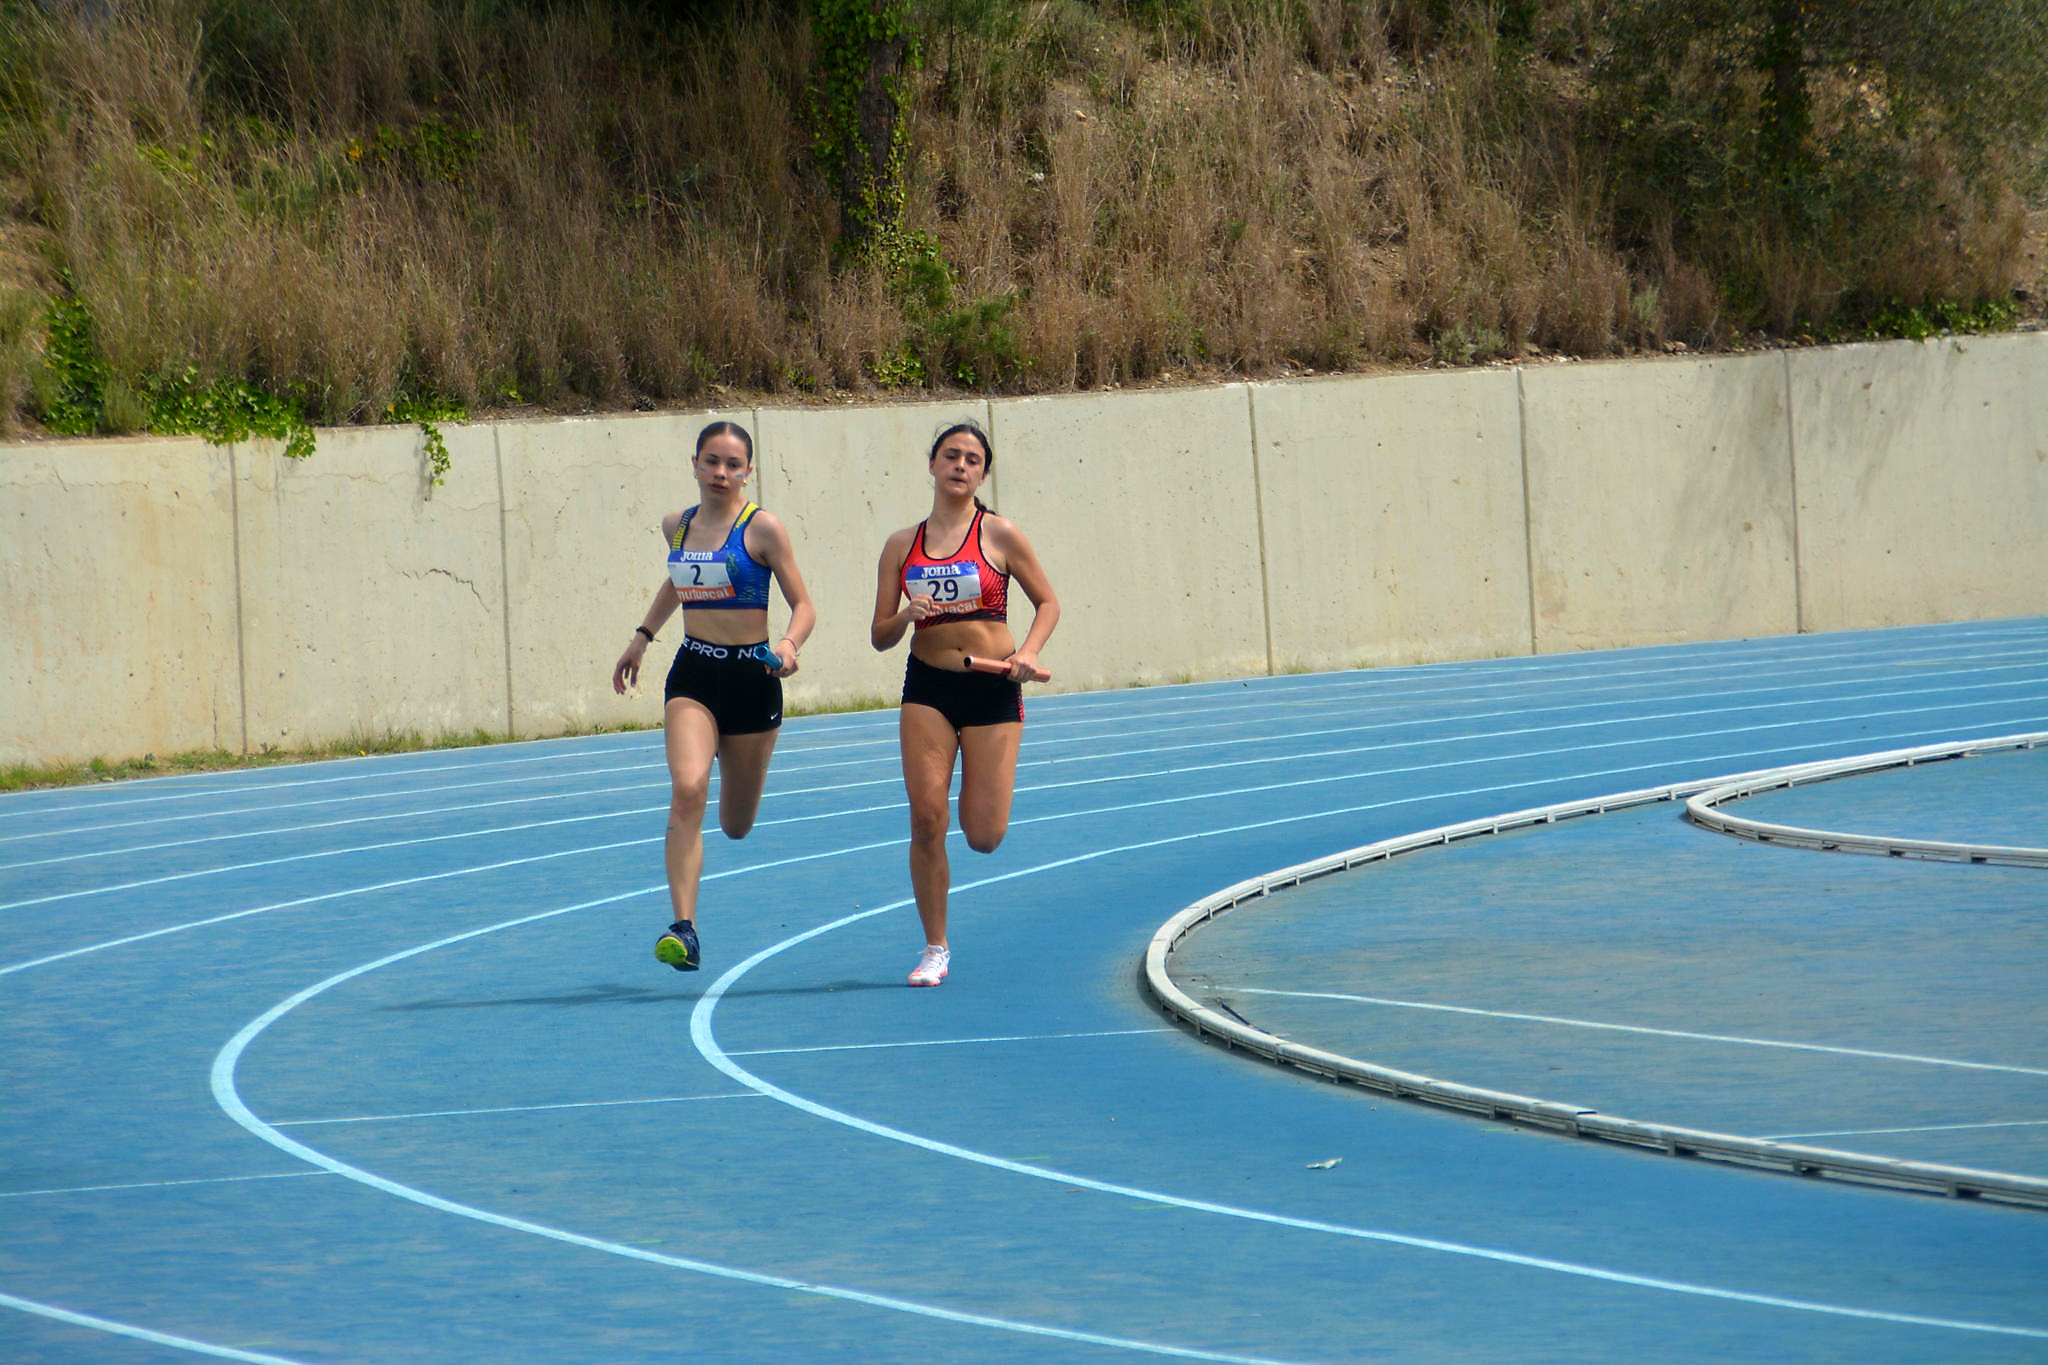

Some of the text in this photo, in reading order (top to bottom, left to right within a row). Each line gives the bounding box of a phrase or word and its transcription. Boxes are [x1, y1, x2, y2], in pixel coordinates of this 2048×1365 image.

[690, 564, 704, 586] 2
[927, 579, 959, 602] 29
[690, 641, 728, 659] PRO
